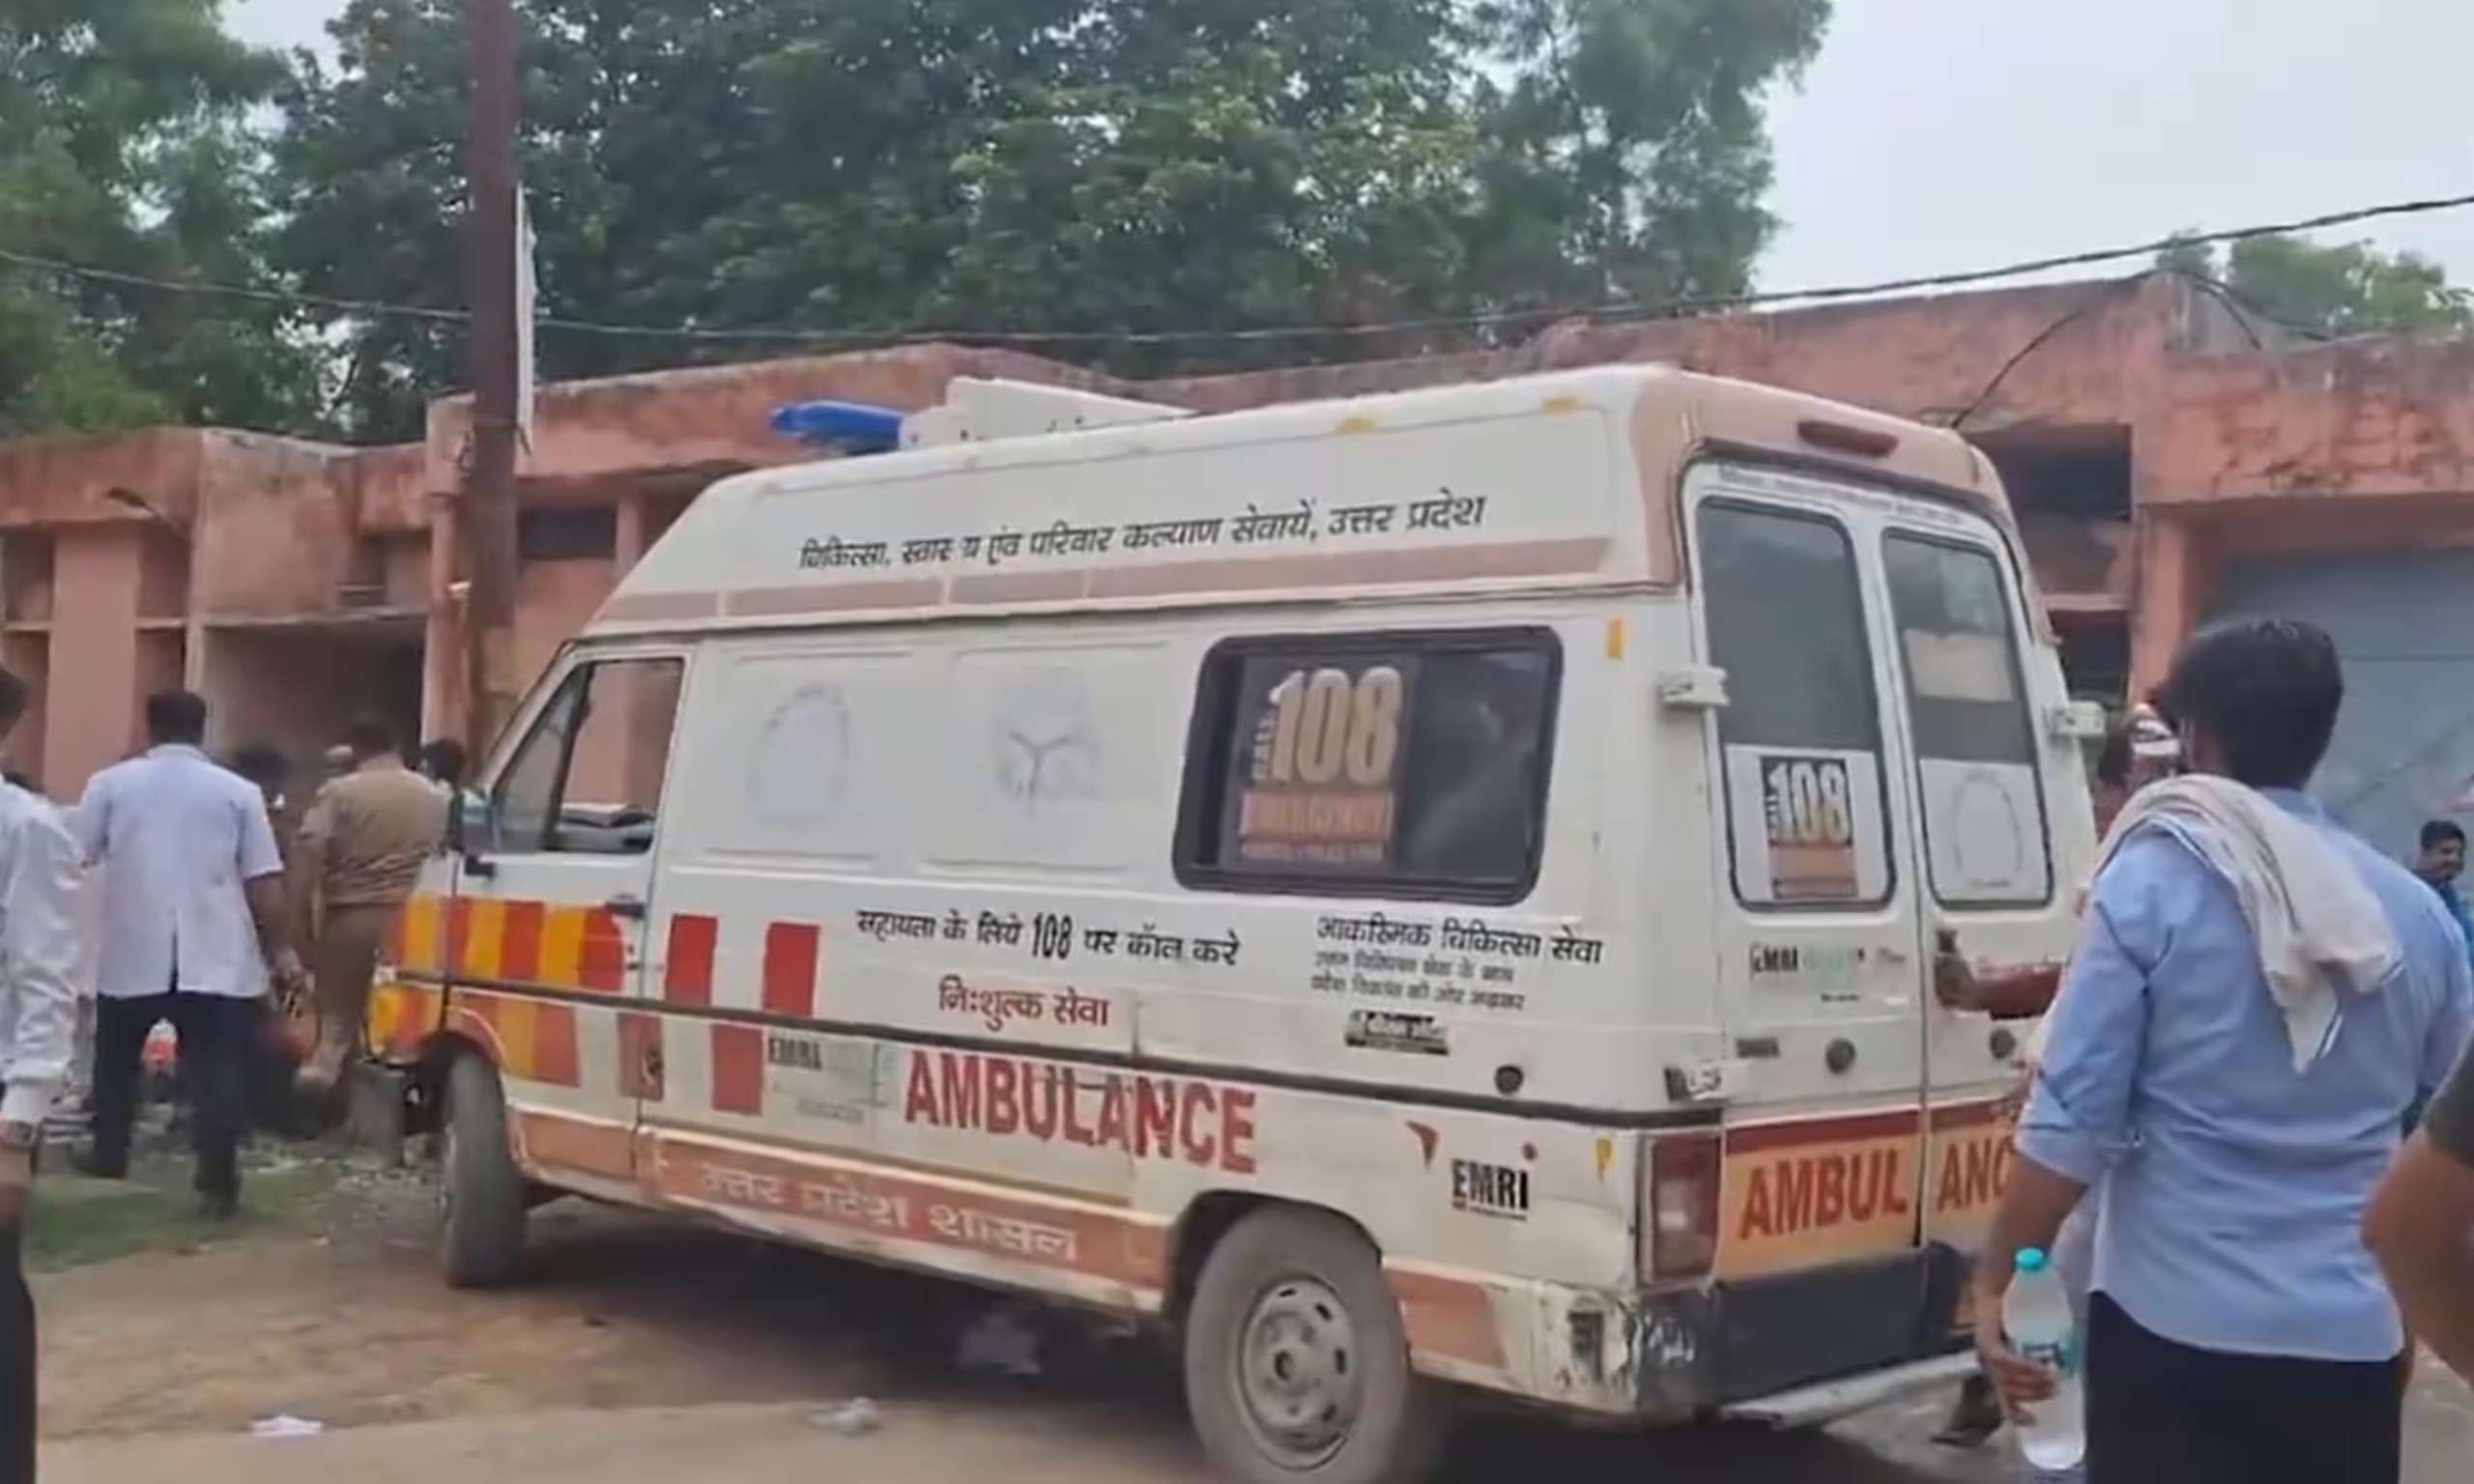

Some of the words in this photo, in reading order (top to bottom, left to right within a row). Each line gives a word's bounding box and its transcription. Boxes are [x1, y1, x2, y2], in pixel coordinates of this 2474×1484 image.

[1029, 519, 1114, 556] परिवार
[1123, 516, 1223, 550] कल्याण
[1328, 503, 1395, 536] उत्तर
[1405, 487, 1487, 530] प्रदेश
[1269, 666, 1401, 787] 108
[1768, 760, 1851, 844] 108
[857, 908, 936, 943] सहायता
[943, 908, 966, 941] के
[977, 910, 1022, 946] लिये
[1031, 913, 1073, 959] 108
[1083, 928, 1118, 955] पर
[1127, 920, 1183, 964] कॉल
[1316, 912, 1432, 948] आकस्मिक
[1441, 917, 1541, 958] चिकित्सा
[1551, 925, 1603, 964] सेवा
[1053, 986, 1110, 1026] सेवा
[904, 1048, 1256, 1175] AMBULANCE
[1452, 1158, 1529, 1211] EMRI
[1738, 1148, 1908, 1241] AMBUL
[1938, 1134, 2015, 1213] ANC
[929, 1203, 1080, 1262] शासन
